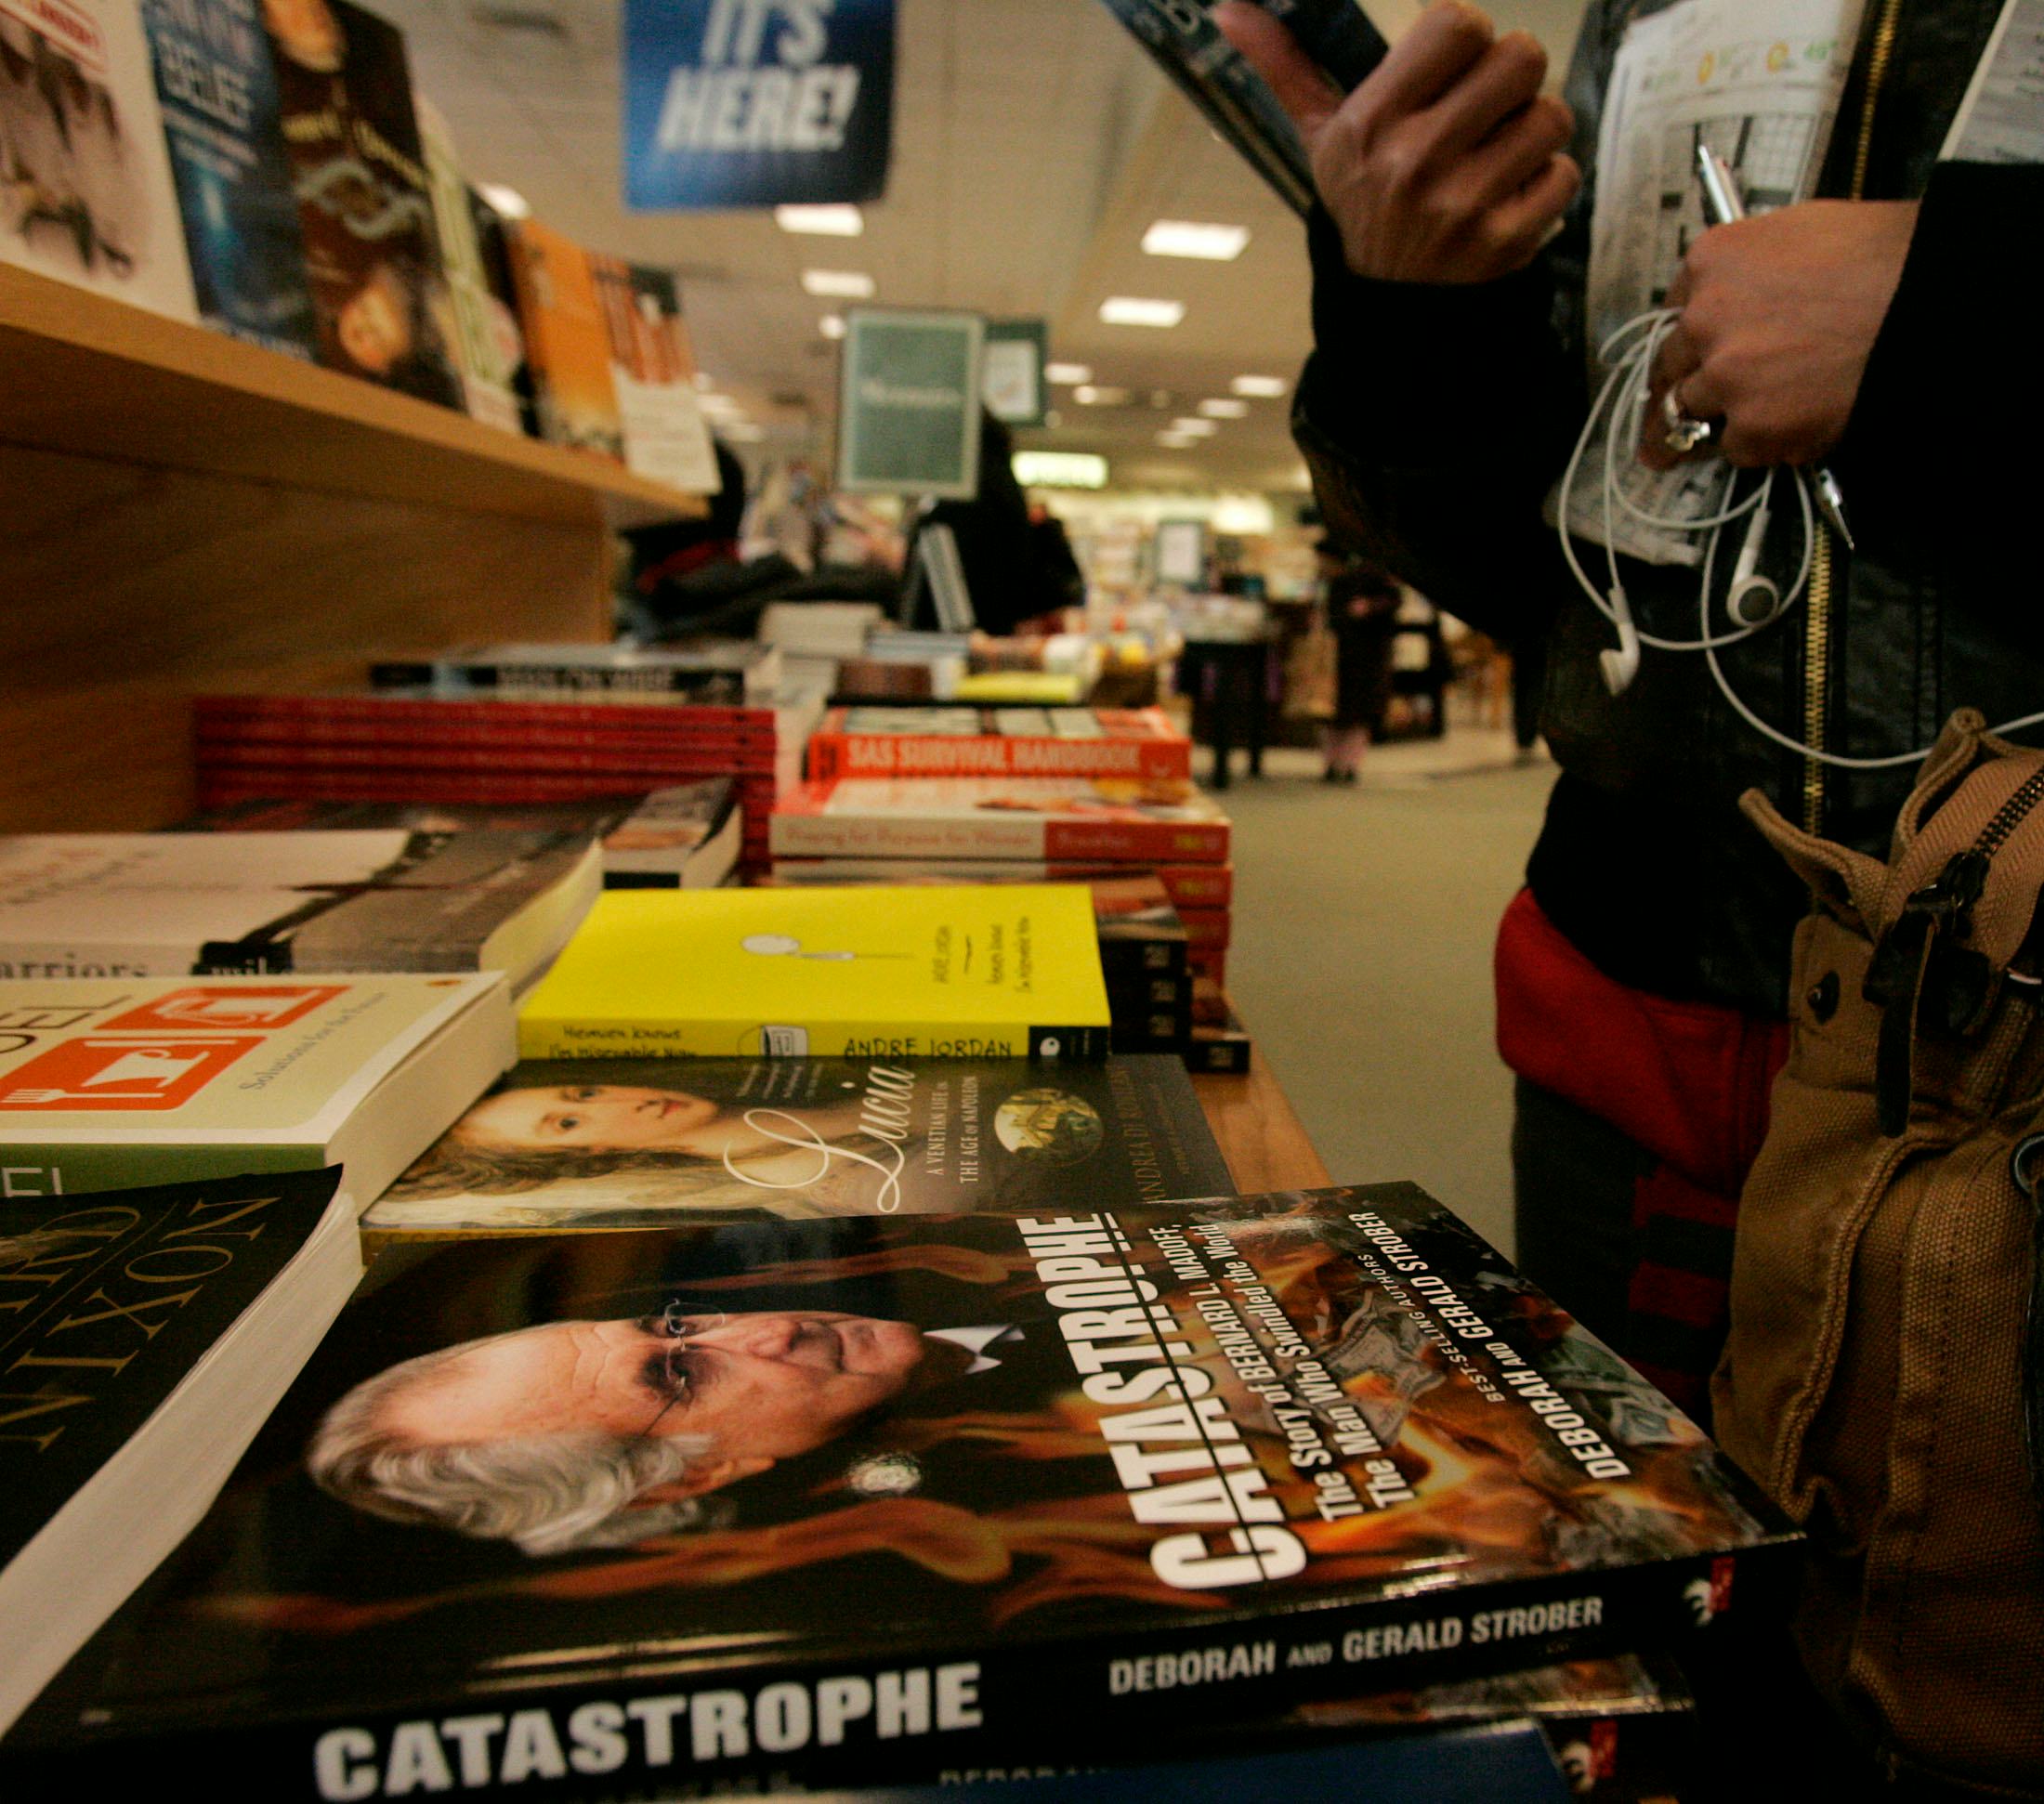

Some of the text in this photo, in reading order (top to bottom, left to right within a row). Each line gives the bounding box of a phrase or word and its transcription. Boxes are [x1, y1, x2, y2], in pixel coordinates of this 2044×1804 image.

[657, 64, 860, 151] HERE!
[847, 739, 895, 768] SAS
[899, 740, 1006, 770] SURVIVAL
[844, 1038, 1012, 1058] ANDRE JORDAN
[931, 1092, 949, 1110] LIFE
[961, 1076, 978, 1122] NAPOLEON
[723, 1065, 915, 1213] Lucia
[926, 1111, 947, 1165] VENETIAN
[961, 1136, 978, 1157] AGE
[960, 1160, 978, 1183] THE
[1148, 1224, 1210, 1280] MADOFF,
[1189, 1282, 1222, 1297] L.
[0, 1196, 282, 1453] NIXON
[1196, 1299, 1277, 1380] BERNARD
[1348, 1211, 1631, 1479] DEBORAH AND GERALD STROBER
[1357, 1254, 1506, 1403] BEST-SELLING AUTHORS
[1188, 1224, 1416, 1509] The Man Who Swindled the World
[1248, 1383, 1292, 1404] of
[1015, 1212, 1306, 1589] CATASTROPHE
[1274, 1408, 1332, 1468] Story
[1314, 1471, 1364, 1523] The
[1109, 1596, 1604, 1695] DEBORAH AND GERALD STROBER
[315, 1663, 982, 1803] CATASTROPHE
